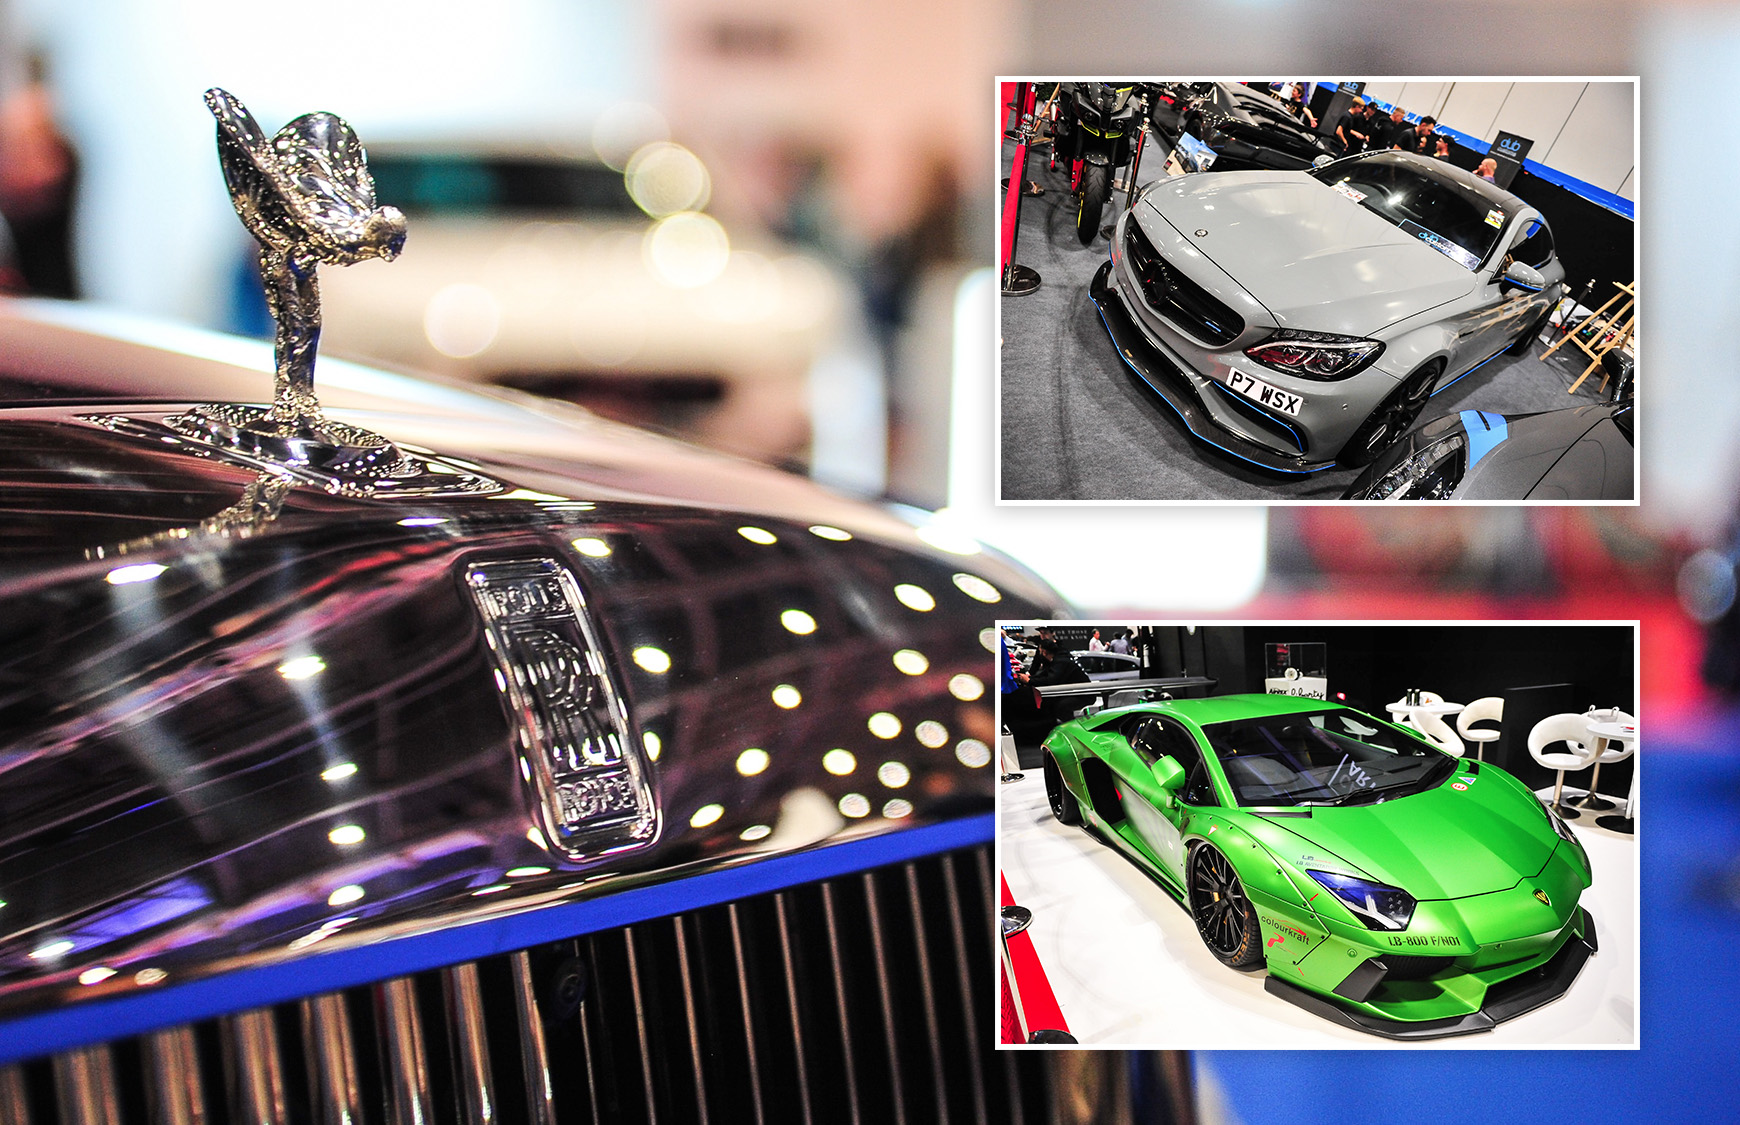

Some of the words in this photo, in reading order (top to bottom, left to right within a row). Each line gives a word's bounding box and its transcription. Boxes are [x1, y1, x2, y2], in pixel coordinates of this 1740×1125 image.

[1500, 138, 1521, 151] dub
[1230, 371, 1256, 394] P7
[1260, 386, 1299, 414] WSX
[1261, 915, 1310, 945] colourkraft
[1387, 935, 1429, 946] LB-800
